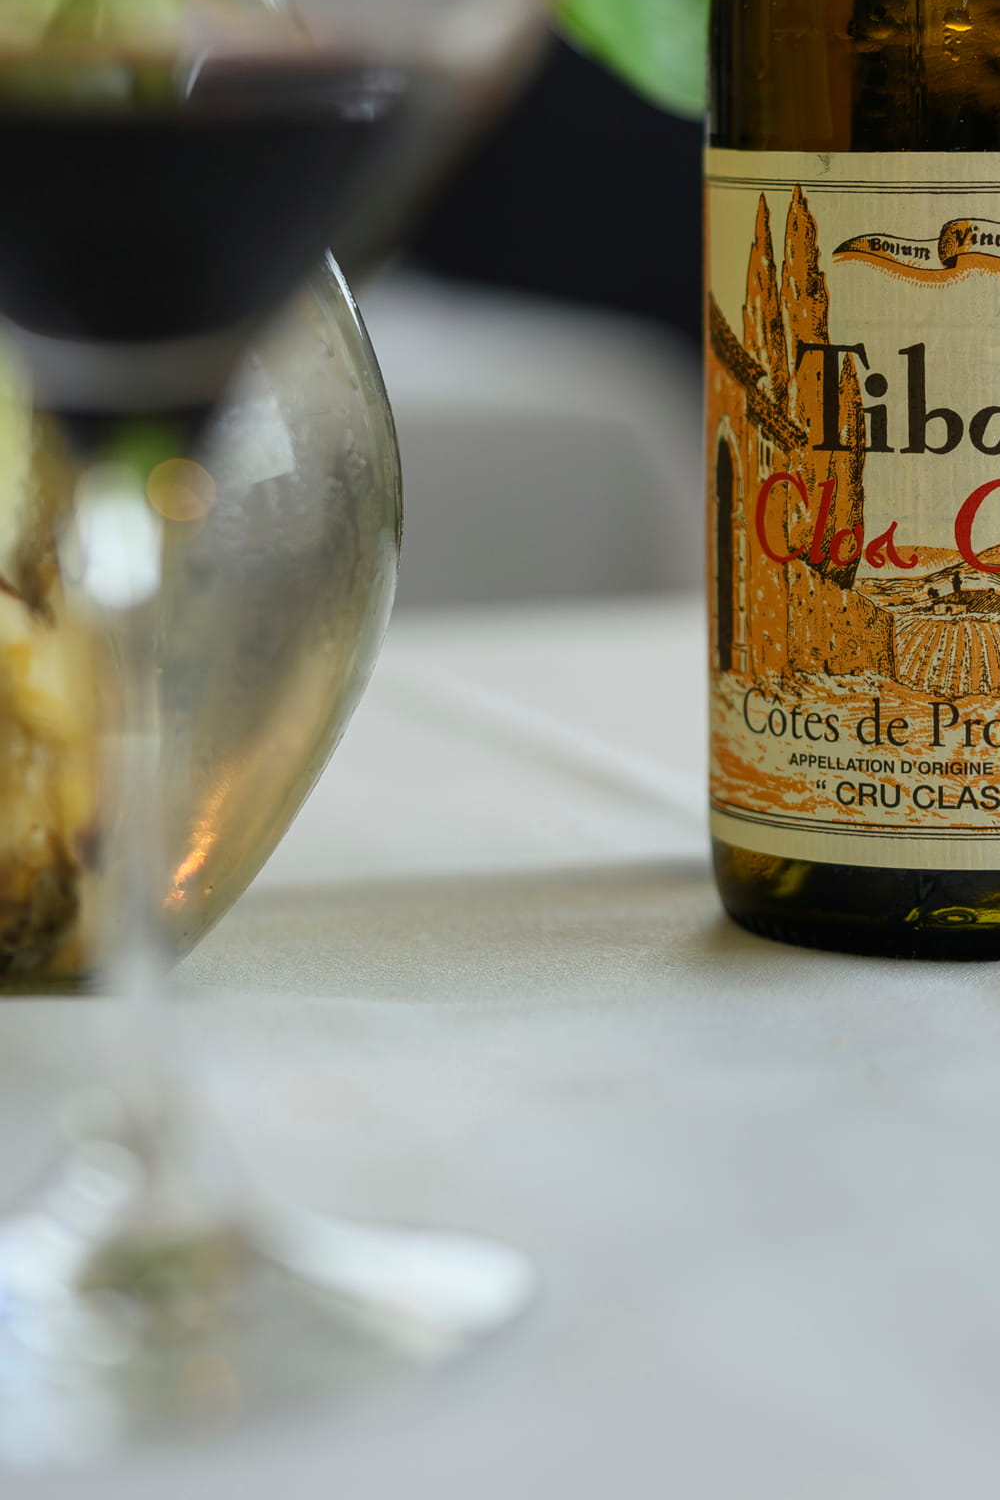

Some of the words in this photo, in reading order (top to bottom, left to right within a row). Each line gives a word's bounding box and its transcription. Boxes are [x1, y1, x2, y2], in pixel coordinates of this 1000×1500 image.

[755, 471, 919, 570] Clos
[742, 686, 841, 746] Côtes
[856, 699, 911, 746] de
[789, 753, 898, 775] APPELLATION
[900, 759, 995, 776] D'ORIGINE
[835, 781, 901, 808] CRU
